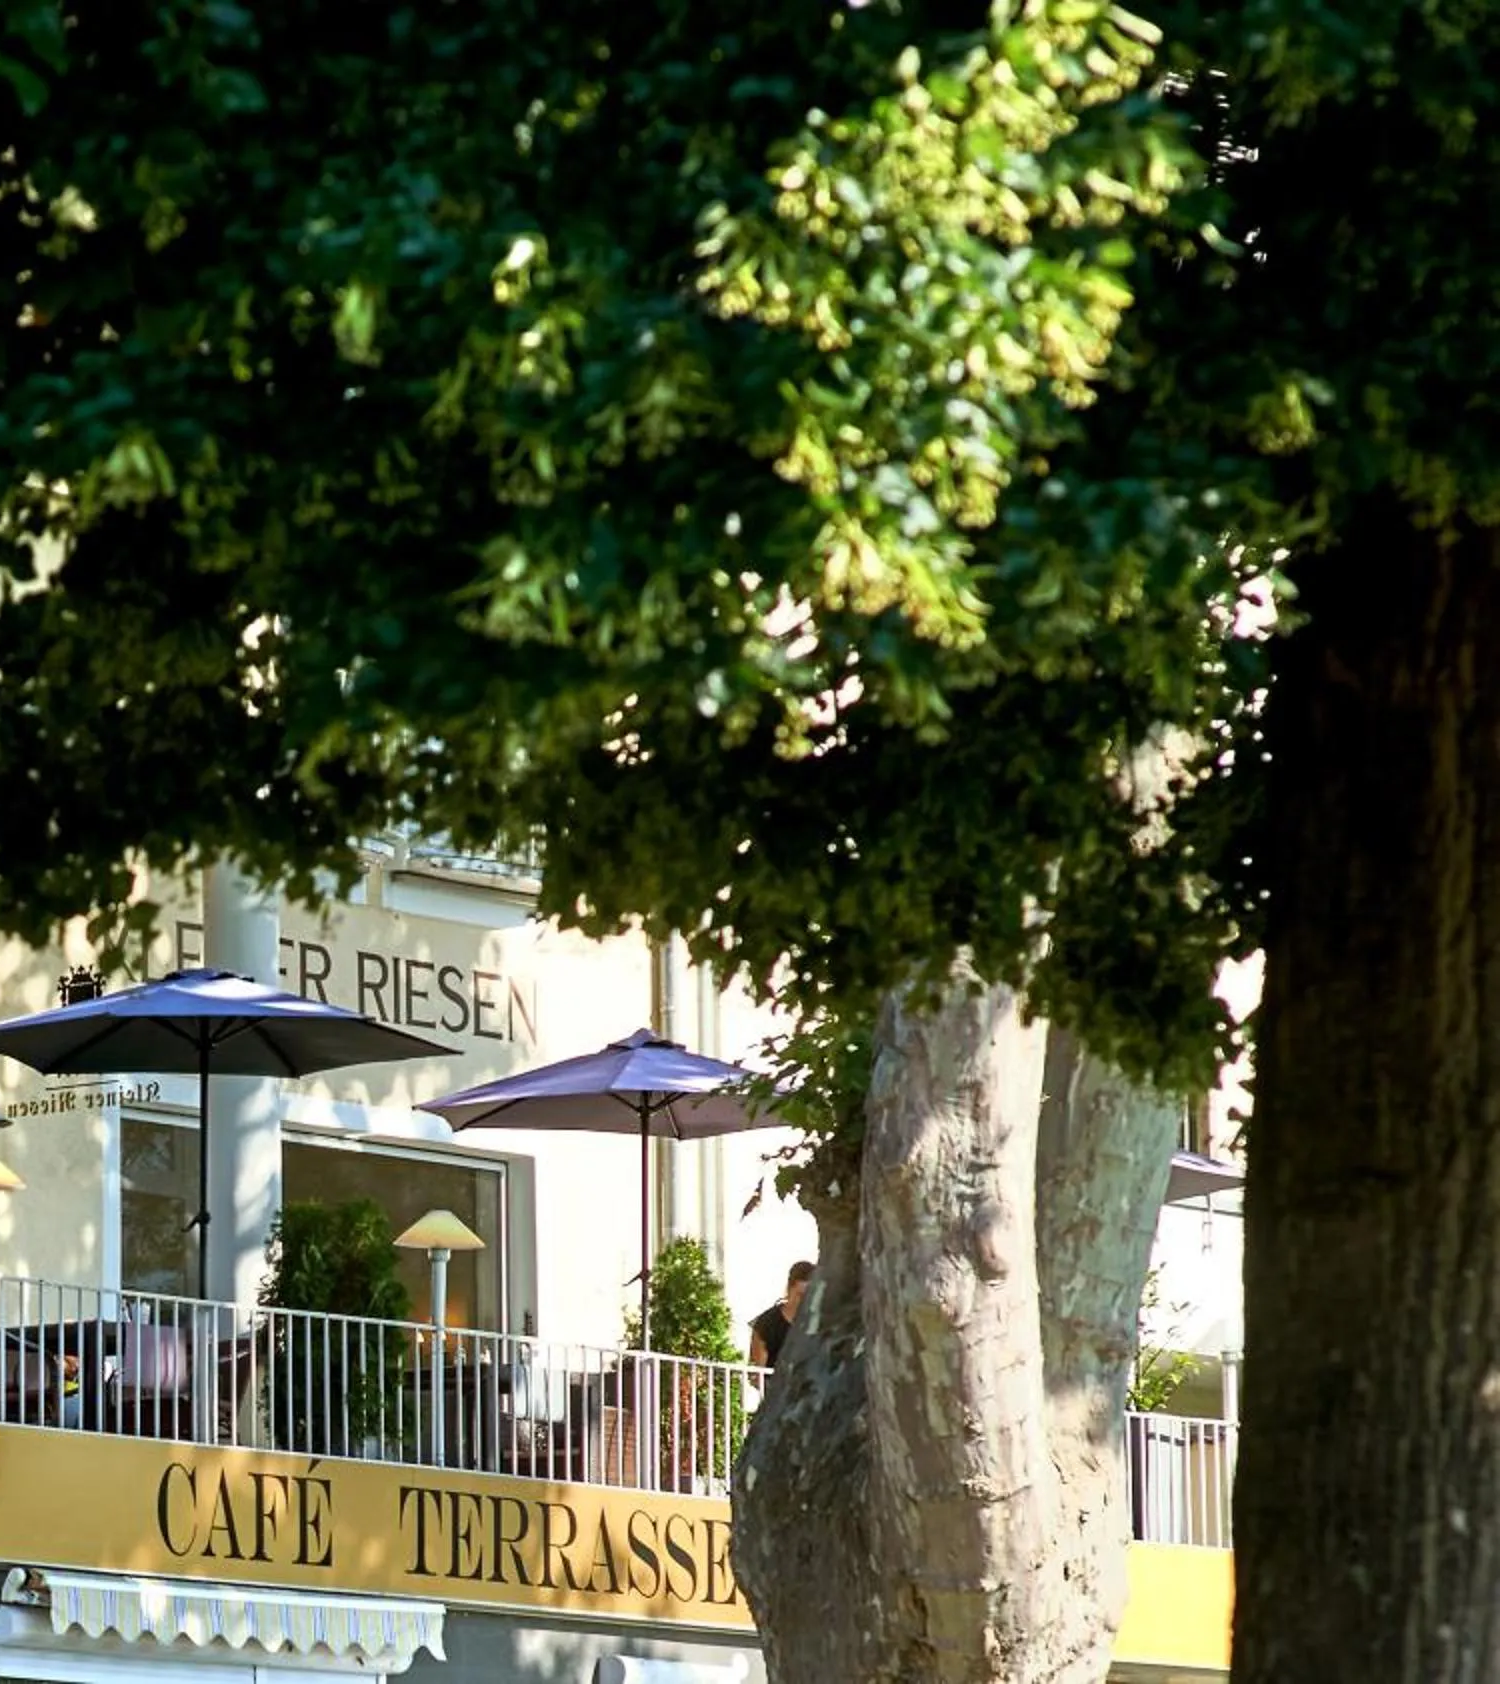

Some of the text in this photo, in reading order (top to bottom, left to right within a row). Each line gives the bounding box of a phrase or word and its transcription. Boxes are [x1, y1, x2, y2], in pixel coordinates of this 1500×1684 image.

[356, 949, 539, 1048] RIESEN
[157, 1457, 738, 1606] CAFÉ TERRASSE
